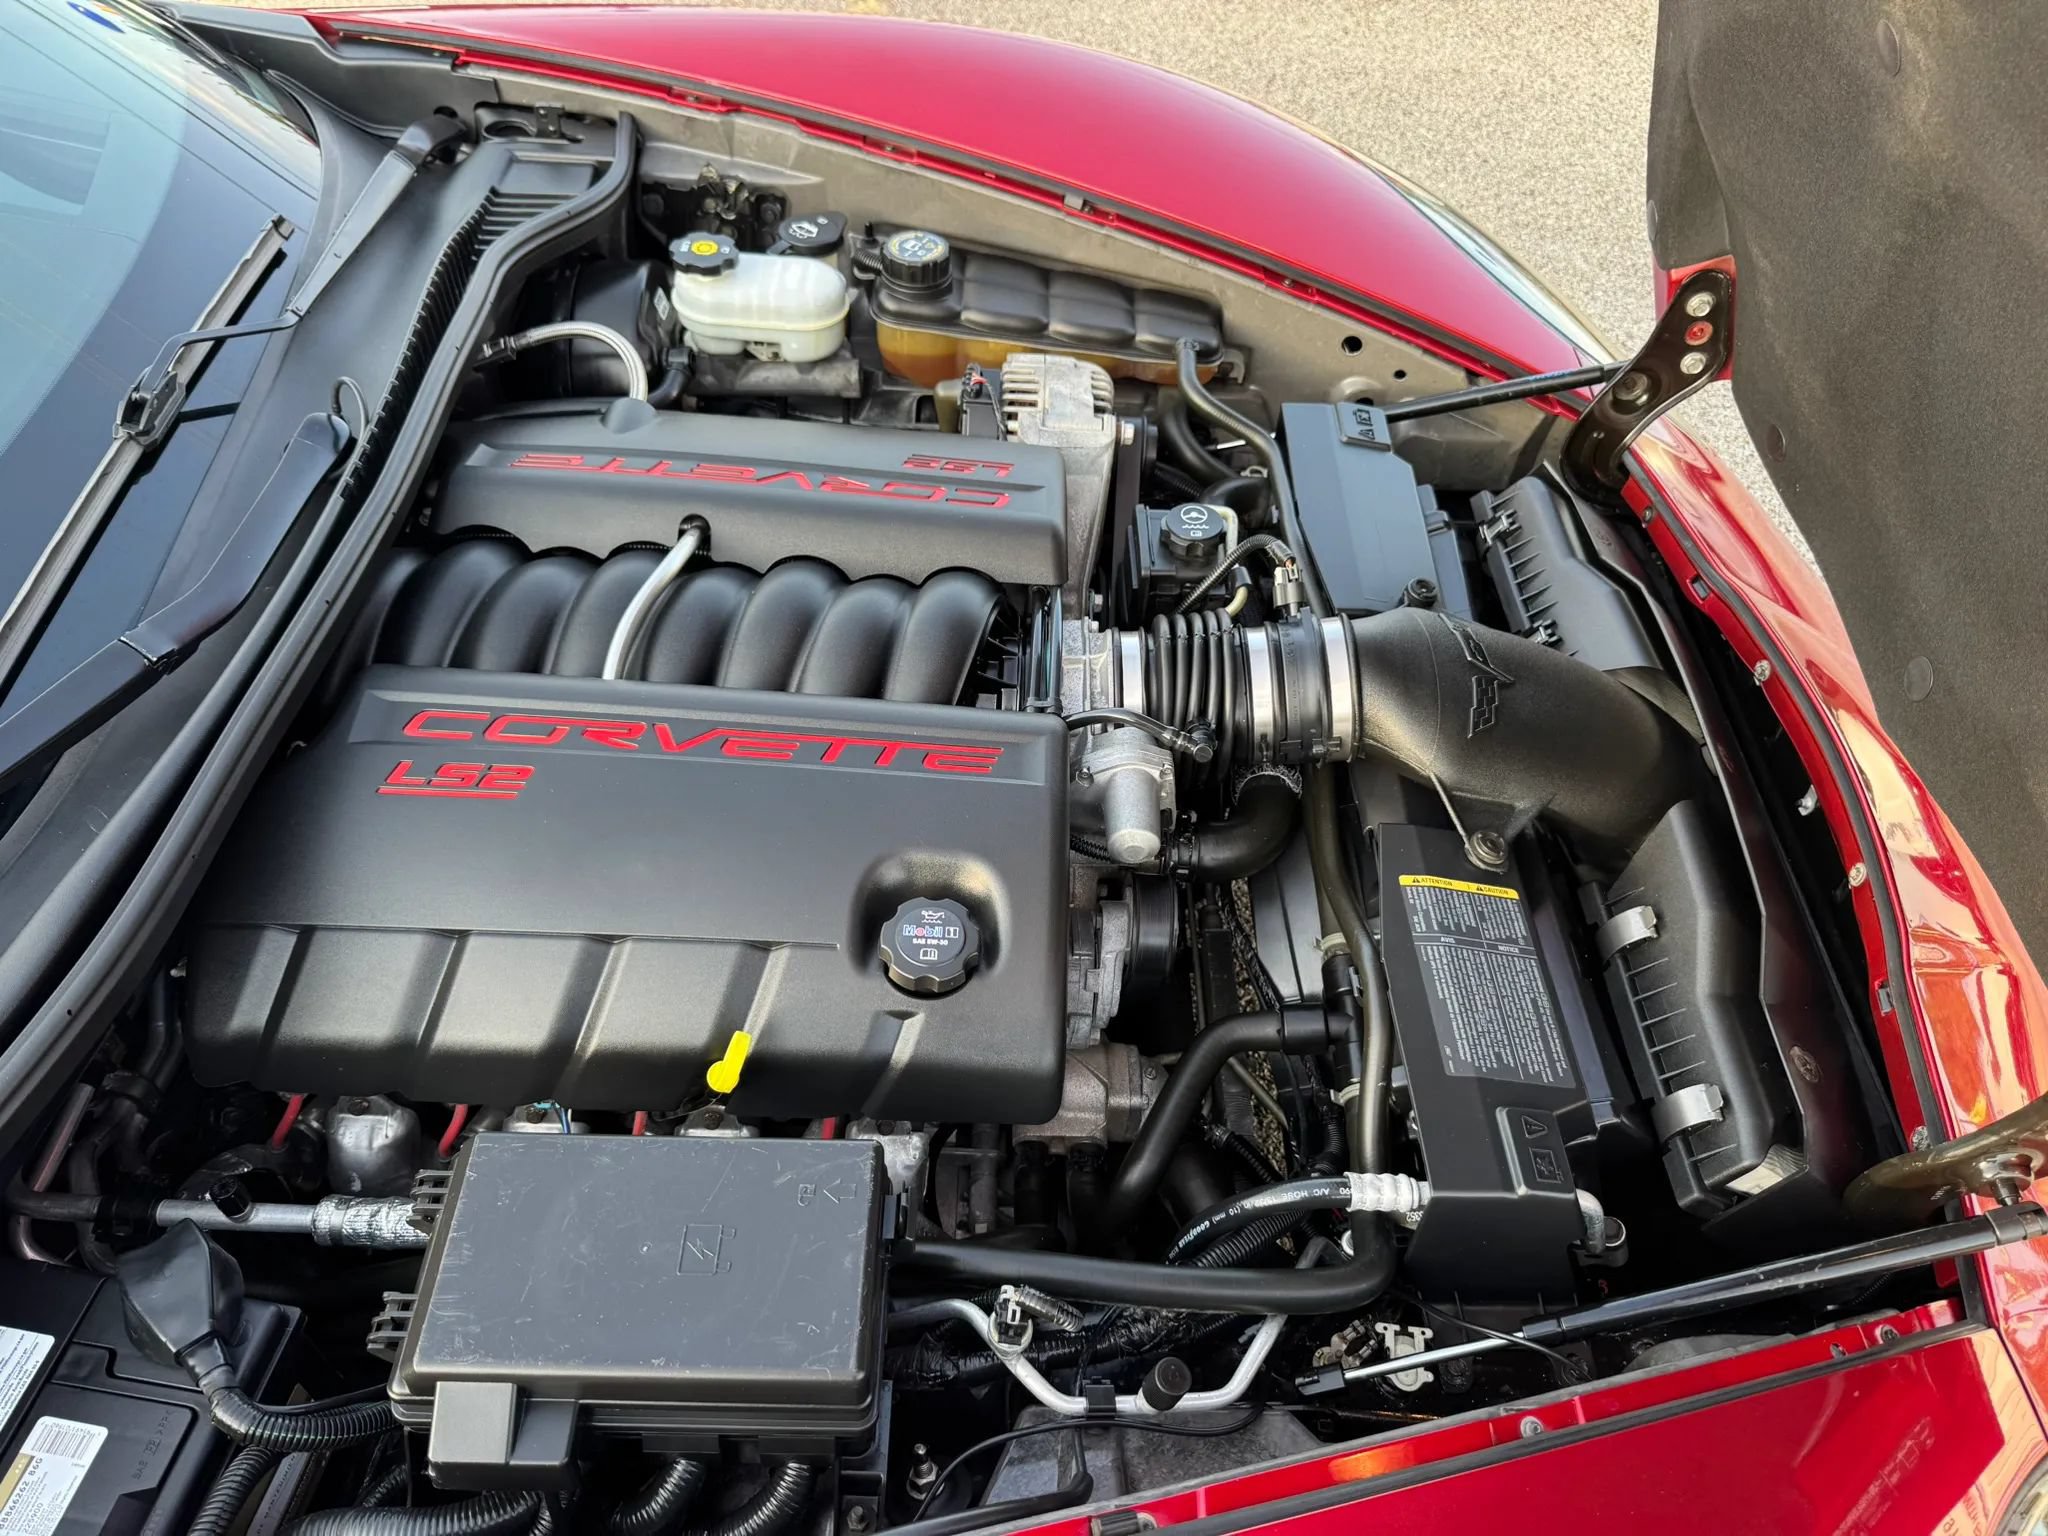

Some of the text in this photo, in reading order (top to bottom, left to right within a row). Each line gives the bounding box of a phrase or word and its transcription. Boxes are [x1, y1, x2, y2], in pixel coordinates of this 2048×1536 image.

[902, 454, 1015, 478] LS2
[509, 454, 1011, 508] CORVETTE
[402, 709, 1005, 773] CORVETTE
[377, 759, 536, 799] LS2
[1421, 877, 1453, 887] ATTENTION
[1483, 887, 1509, 896] CAUTION
[903, 924, 959, 938] Mobil 1
[927, 938, 949, 946] 5W-30
[1440, 936, 1456, 944] AVIS
[1497, 945, 1519, 954] NOTICE
[1280, 1190, 1309, 1200] HOSE
[1313, 1187, 1330, 1197] A/C
[1339, 1187, 1351, 1195] 90
[1178, 1220, 1211, 1249] GOODYEAR
